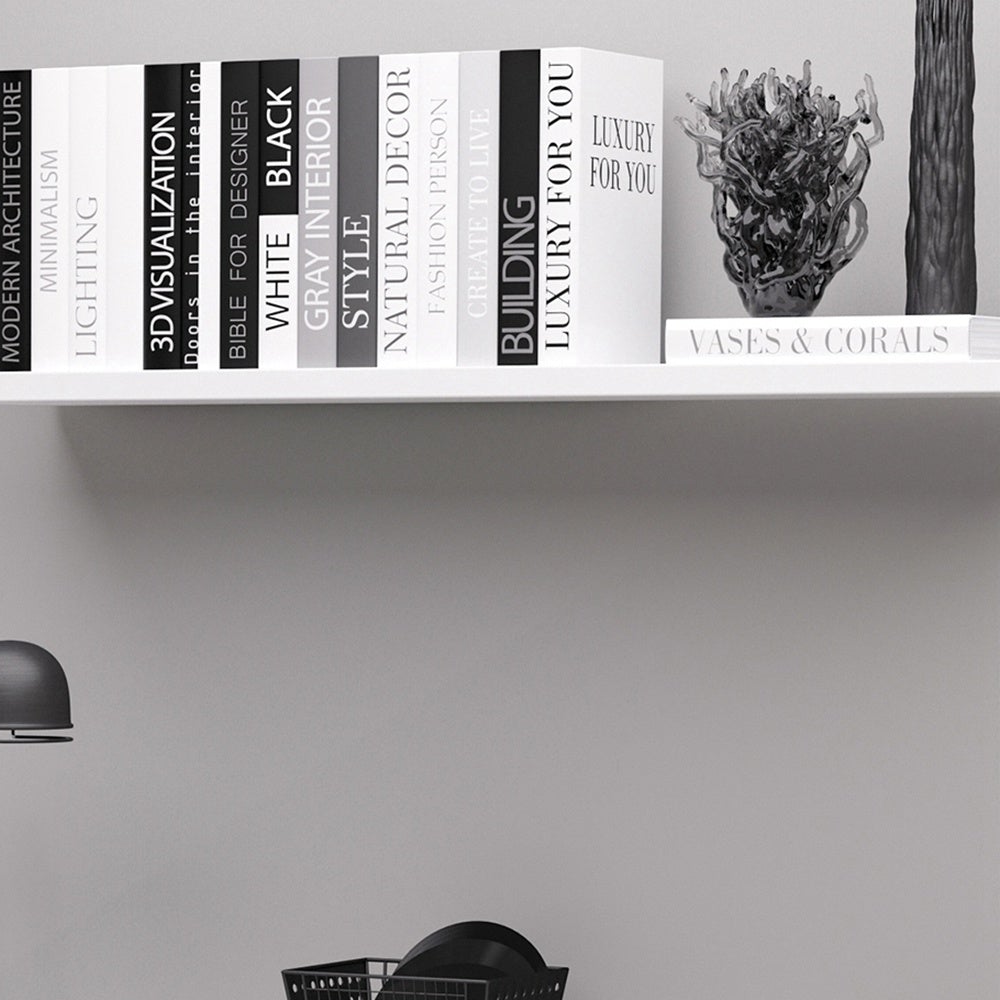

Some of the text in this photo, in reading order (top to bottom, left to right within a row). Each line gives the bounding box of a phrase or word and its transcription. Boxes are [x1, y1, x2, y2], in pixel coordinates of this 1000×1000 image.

[2, 82, 22, 362] MODERN ARCHITECTURE
[40, 150, 58, 292] MINIMALISM
[150, 112, 175, 352] 3D VISUALIZATION
[184, 69, 201, 364] Doors in the interior
[230, 99, 248, 359] BIBLE FOR DESIGNER
[266, 86, 292, 331] WHITE BLACK
[304, 97, 331, 331] GRAY INTERIOR
[384, 67, 411, 354] NATURAL DECOR
[428, 98, 448, 315] FASHION PERSON
[467, 107, 490, 319] CREATE TO LIVE
[545, 62, 574, 351] LUXURY FOR YOU
[590, 157, 657, 195] FOR YOU
[592, 115, 655, 153] LUXURY
[76, 197, 98, 356] LIGHTING
[342, 214, 370, 329] STYLE
[501, 196, 536, 355] BUILDING
[690, 326, 949, 355] VASES & CORALS
